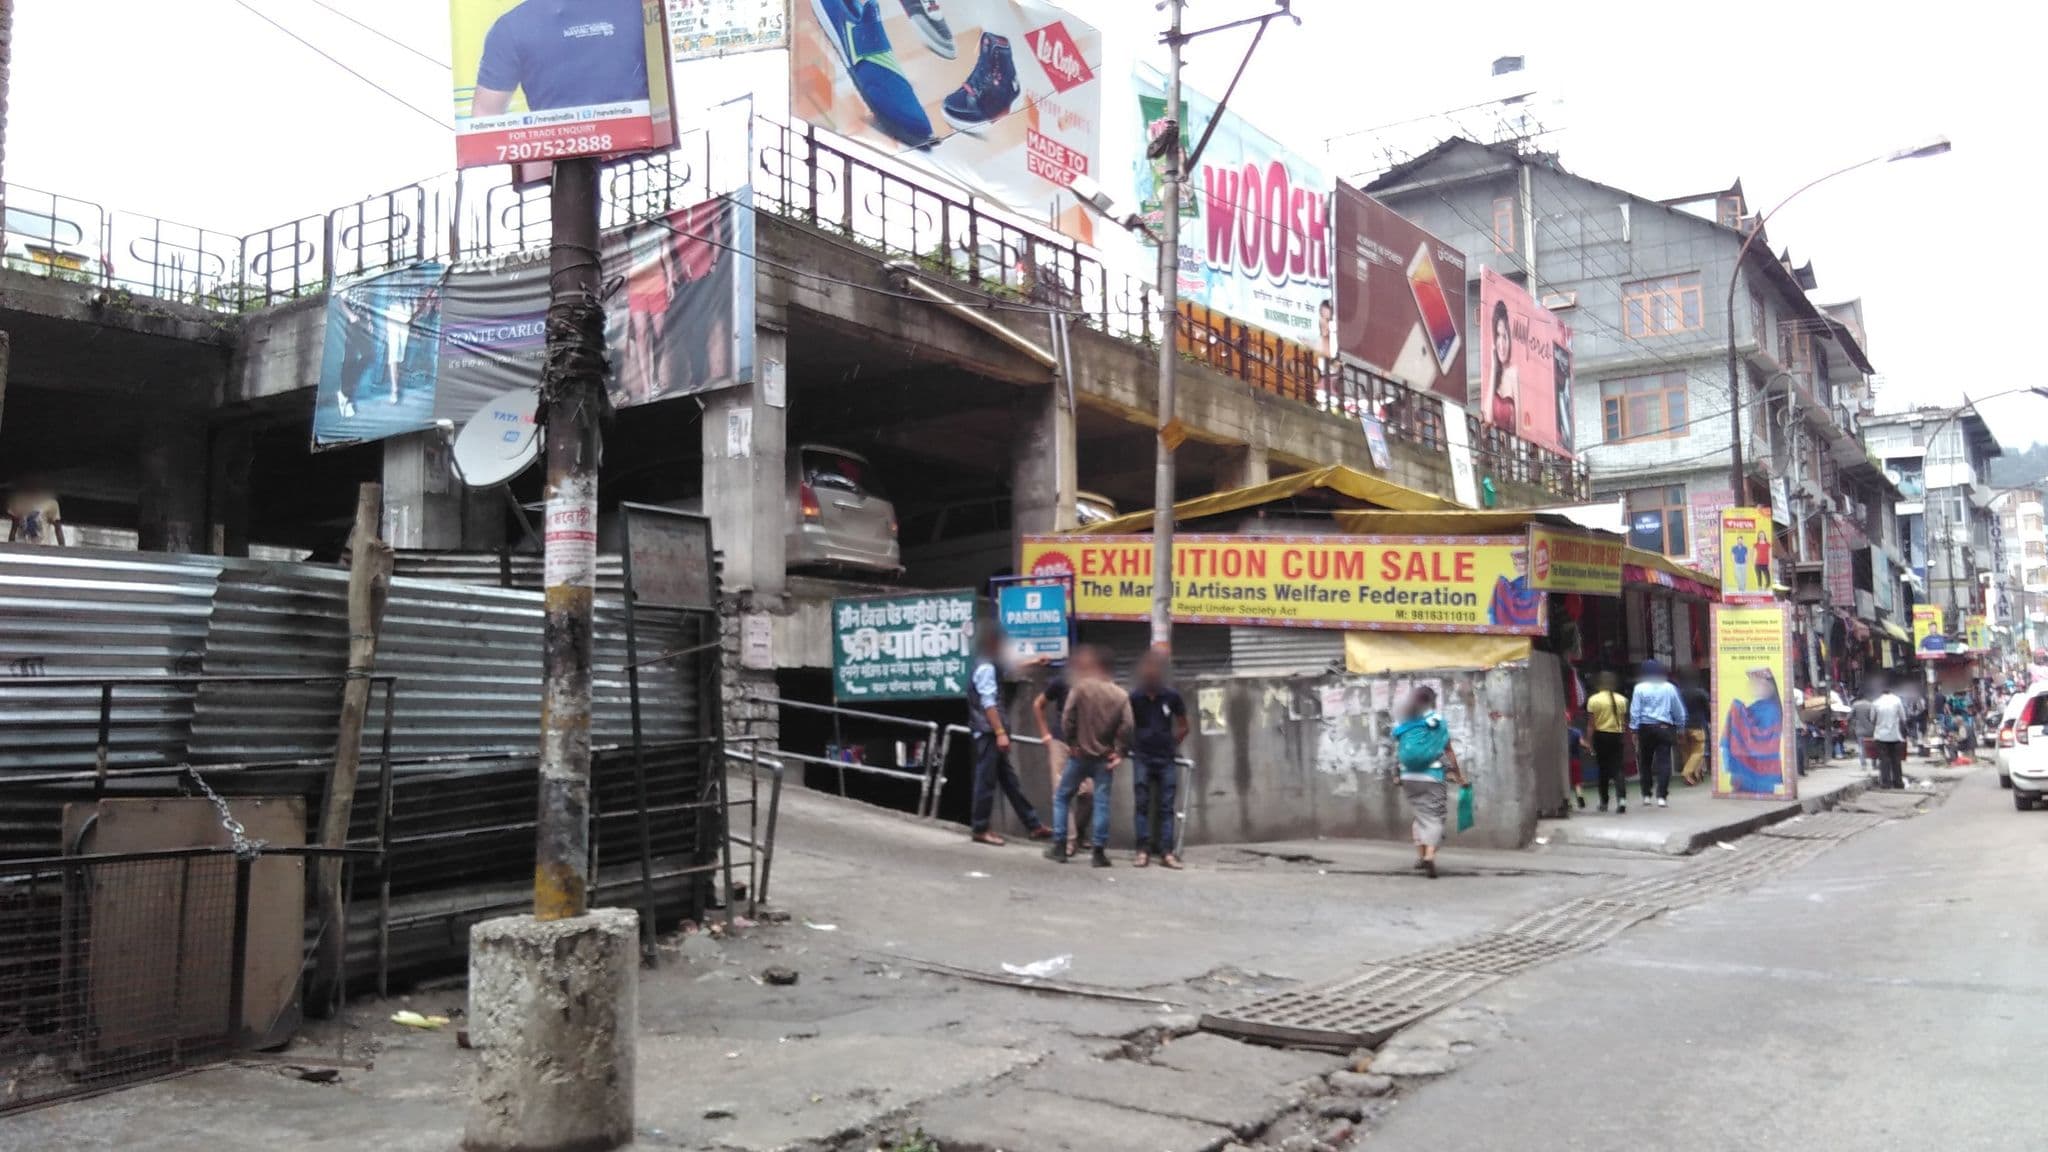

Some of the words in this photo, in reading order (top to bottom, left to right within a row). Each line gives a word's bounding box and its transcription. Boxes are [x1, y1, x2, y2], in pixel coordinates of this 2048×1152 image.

[470, 121, 495, 131] Follow
[497, 120, 506, 128] us
[507, 118, 521, 127] on:
[509, 130, 527, 140] FOR
[528, 128, 556, 138] TRADE
[558, 125, 597, 137] ENQUIRY
[496, 135, 613, 161] 7307522888
[1028, 131, 1065, 165] MADE
[1065, 151, 1086, 172] TO
[1028, 154, 1072, 185] EVOKE
[1203, 161, 1329, 280] WOOSH
[446, 328, 495, 346] MONTE
[498, 321, 546, 341] CARLO
[493, 411, 519, 423] TATA
[1081, 549, 1267, 578] EXHIITION
[1282, 550, 1365, 581] CUM
[1380, 551, 1475, 583] SALE
[1081, 581, 1113, 597] The
[1119, 581, 1180, 598] Mali
[1187, 582, 1267, 600] Artisans
[1274, 584, 1351, 602] Welfare
[1358, 586, 1477, 607] Federation
[1006, 609, 1061, 624] PARKING
[1176, 603, 1202, 615] Regd
[1206, 603, 1236, 614] Under
[1238, 605, 1277, 617] Society
[1278, 606, 1297, 617] Act
[1395, 610, 1407, 620] M:
